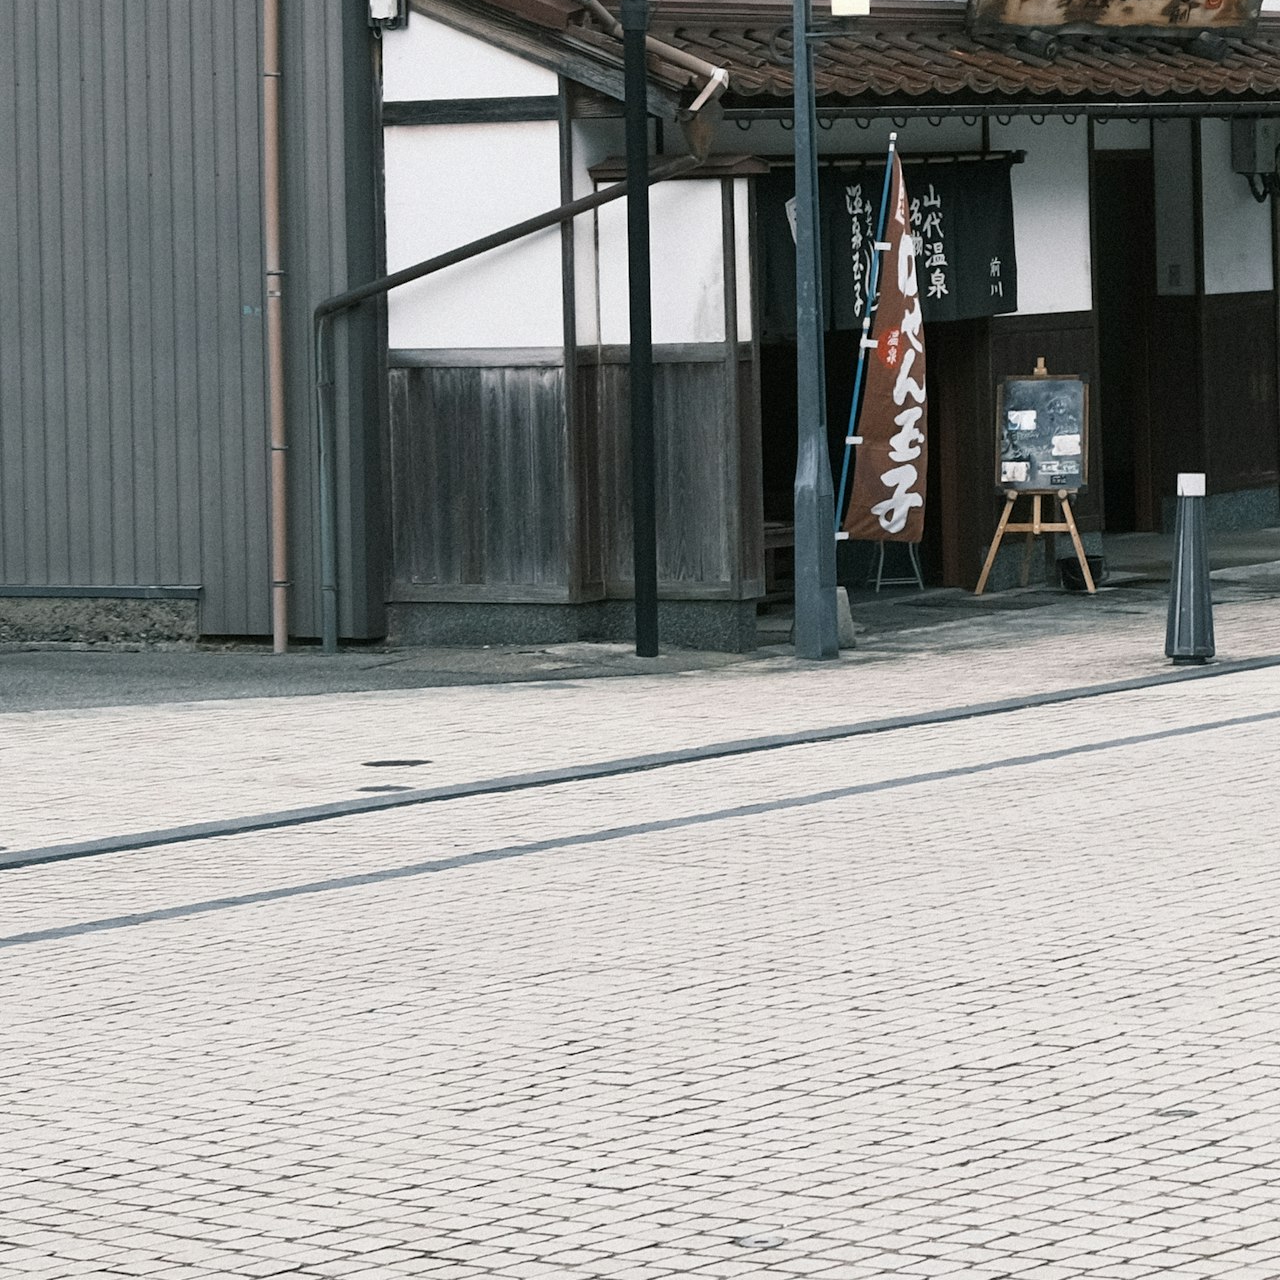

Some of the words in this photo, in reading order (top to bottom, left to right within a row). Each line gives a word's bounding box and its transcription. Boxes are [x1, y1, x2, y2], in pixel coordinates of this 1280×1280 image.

[909, 198, 923, 257] 名物
[922, 184, 948, 299] 山代温泉
[990, 256, 1003, 297] 前川
[886, 329, 900, 365] 温泉
